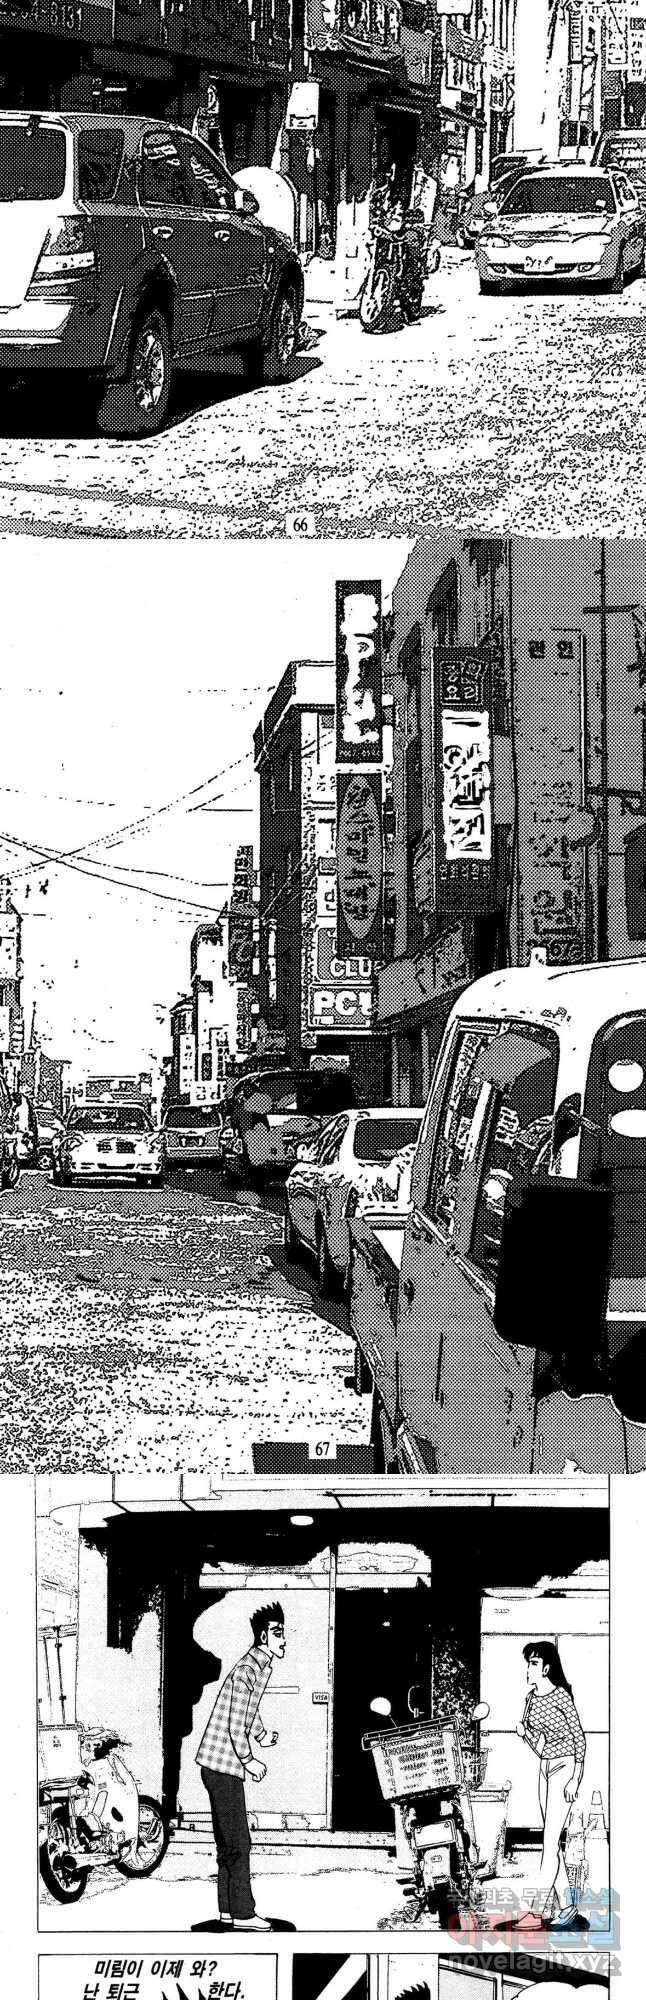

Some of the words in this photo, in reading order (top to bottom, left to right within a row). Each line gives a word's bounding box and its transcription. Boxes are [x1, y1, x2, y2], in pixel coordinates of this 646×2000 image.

[293, 517, 308, 532] 66
[315, 1441, 330, 1456] 67
[94, 1959, 144, 1979] 미림이
[150, 1959, 184, 1979] 이제
[190, 1960, 218, 1979] 와?
[82, 1982, 100, 2000] 난
